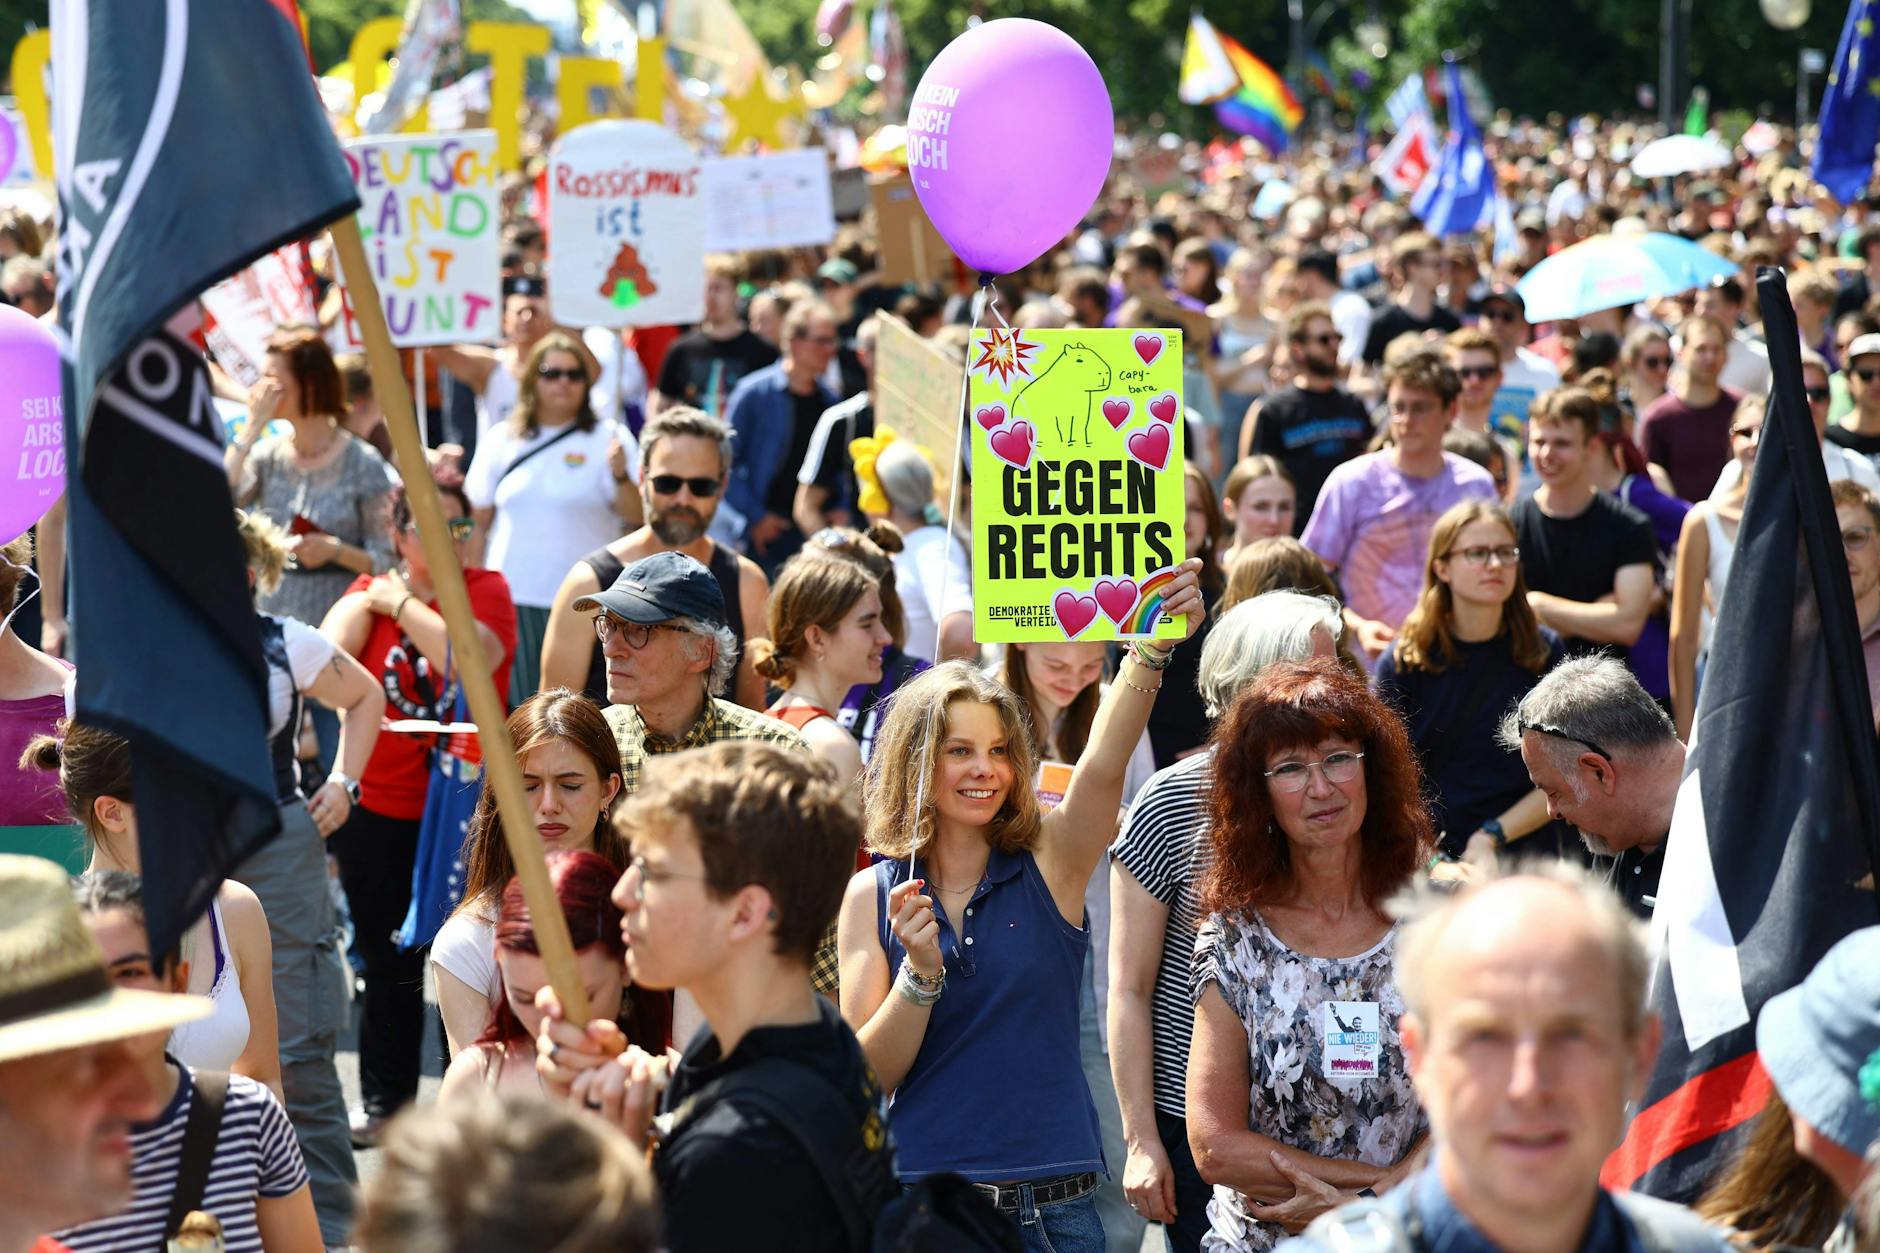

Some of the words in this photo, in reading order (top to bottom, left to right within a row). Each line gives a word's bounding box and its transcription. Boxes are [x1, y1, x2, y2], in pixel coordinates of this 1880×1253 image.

[555, 161, 701, 198] Rassismus
[595, 201, 643, 236] ist
[1128, 385, 1158, 394] bara
[22, 397, 50, 420] SEI
[1002, 460, 1156, 516] GEGEN
[988, 522, 1173, 580] RECHTS
[989, 605, 1051, 617] DEMOKRATIE
[1327, 1032, 1342, 1045] NIE
